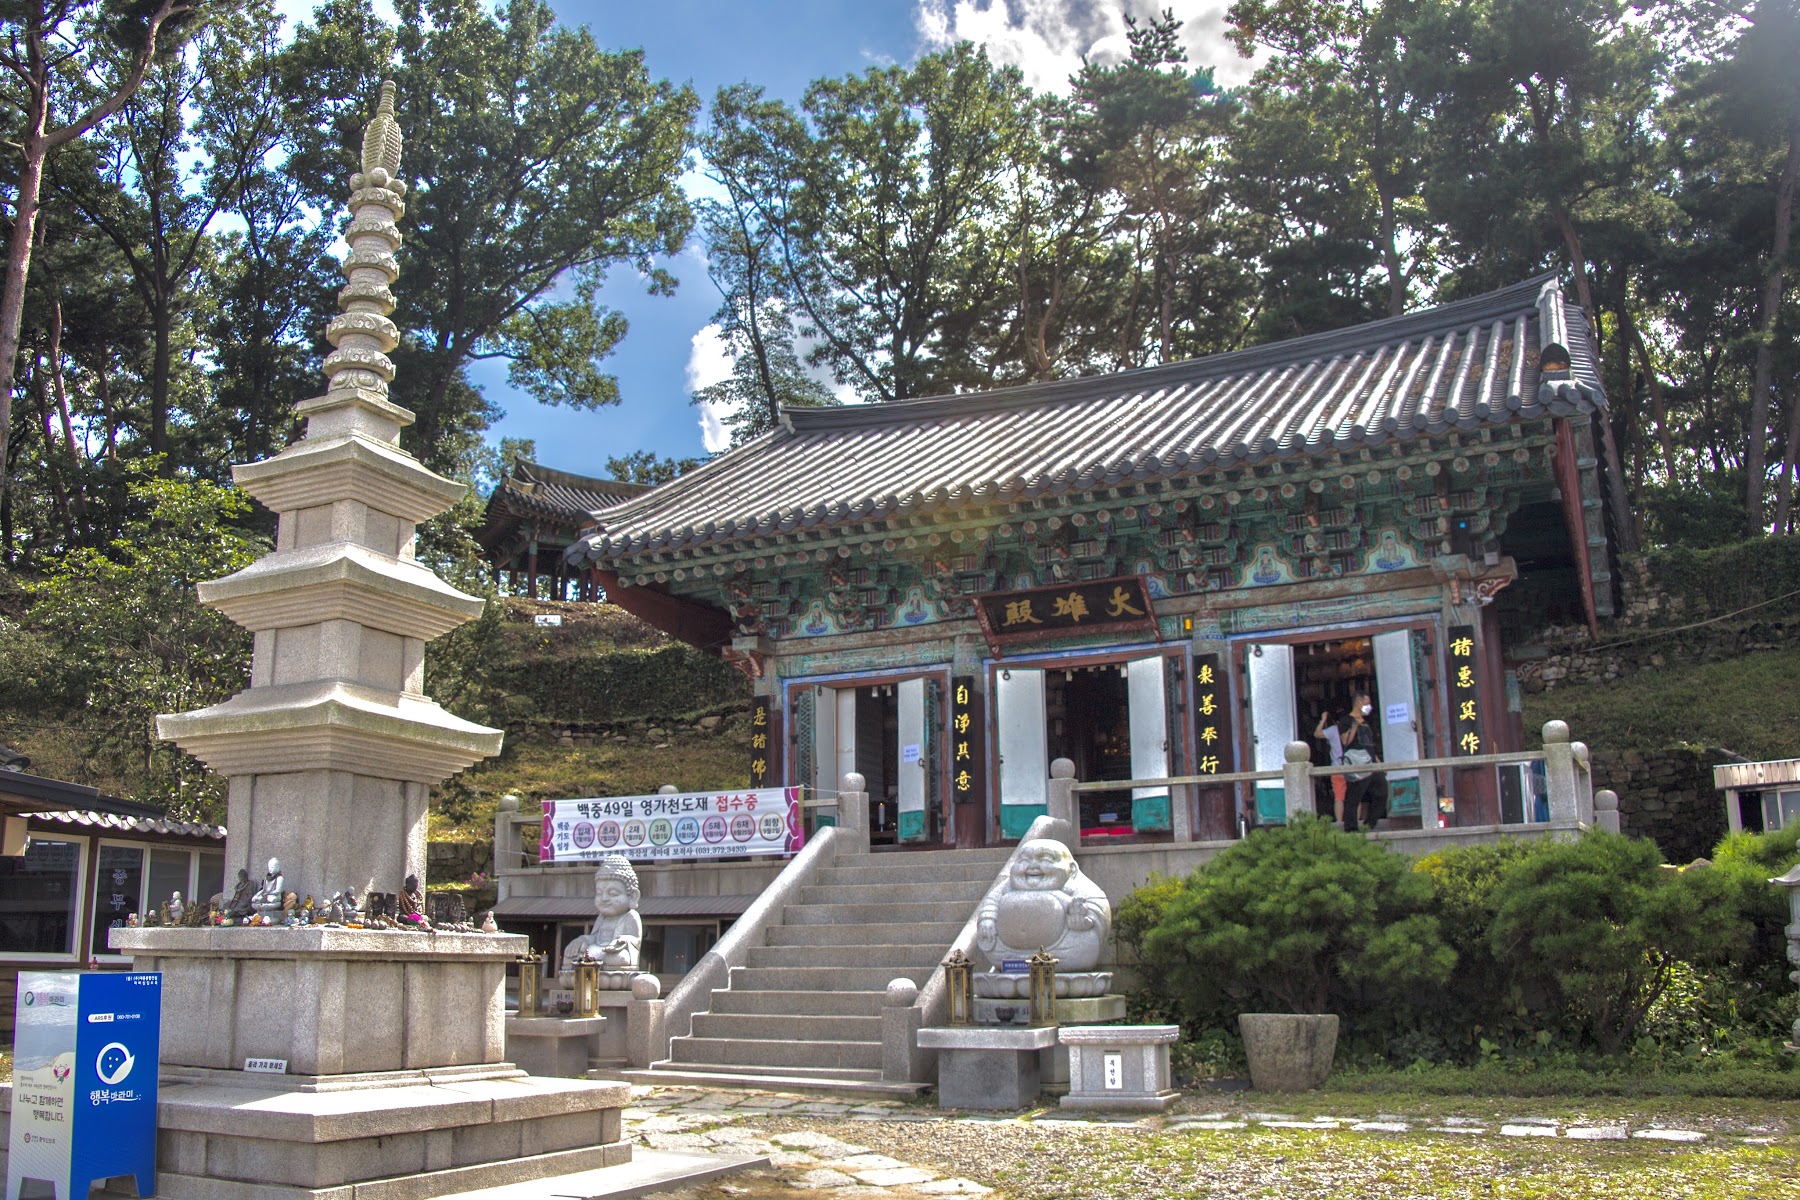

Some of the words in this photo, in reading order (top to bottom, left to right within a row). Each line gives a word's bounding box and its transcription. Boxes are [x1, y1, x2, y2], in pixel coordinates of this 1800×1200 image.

[752, 706, 767, 788] 是諸佛
[577, 800, 634, 819] 백중49일
[640, 796, 709, 816] 영가천도재
[716, 793, 758, 812] 접수중
[654, 824, 667, 833] 3재
[681, 823, 694, 831] 4재
[708, 821, 721, 830] 5재
[736, 820, 749, 829] 6재
[628, 825, 640, 834] 2재
[557, 832, 570, 841] 기도
[650, 846, 670, 857] 세마대
[672, 846, 693, 856] 보적사
[19, 1093, 38, 1105] 나누고
[39, 1095, 64, 1108] 함께하면
